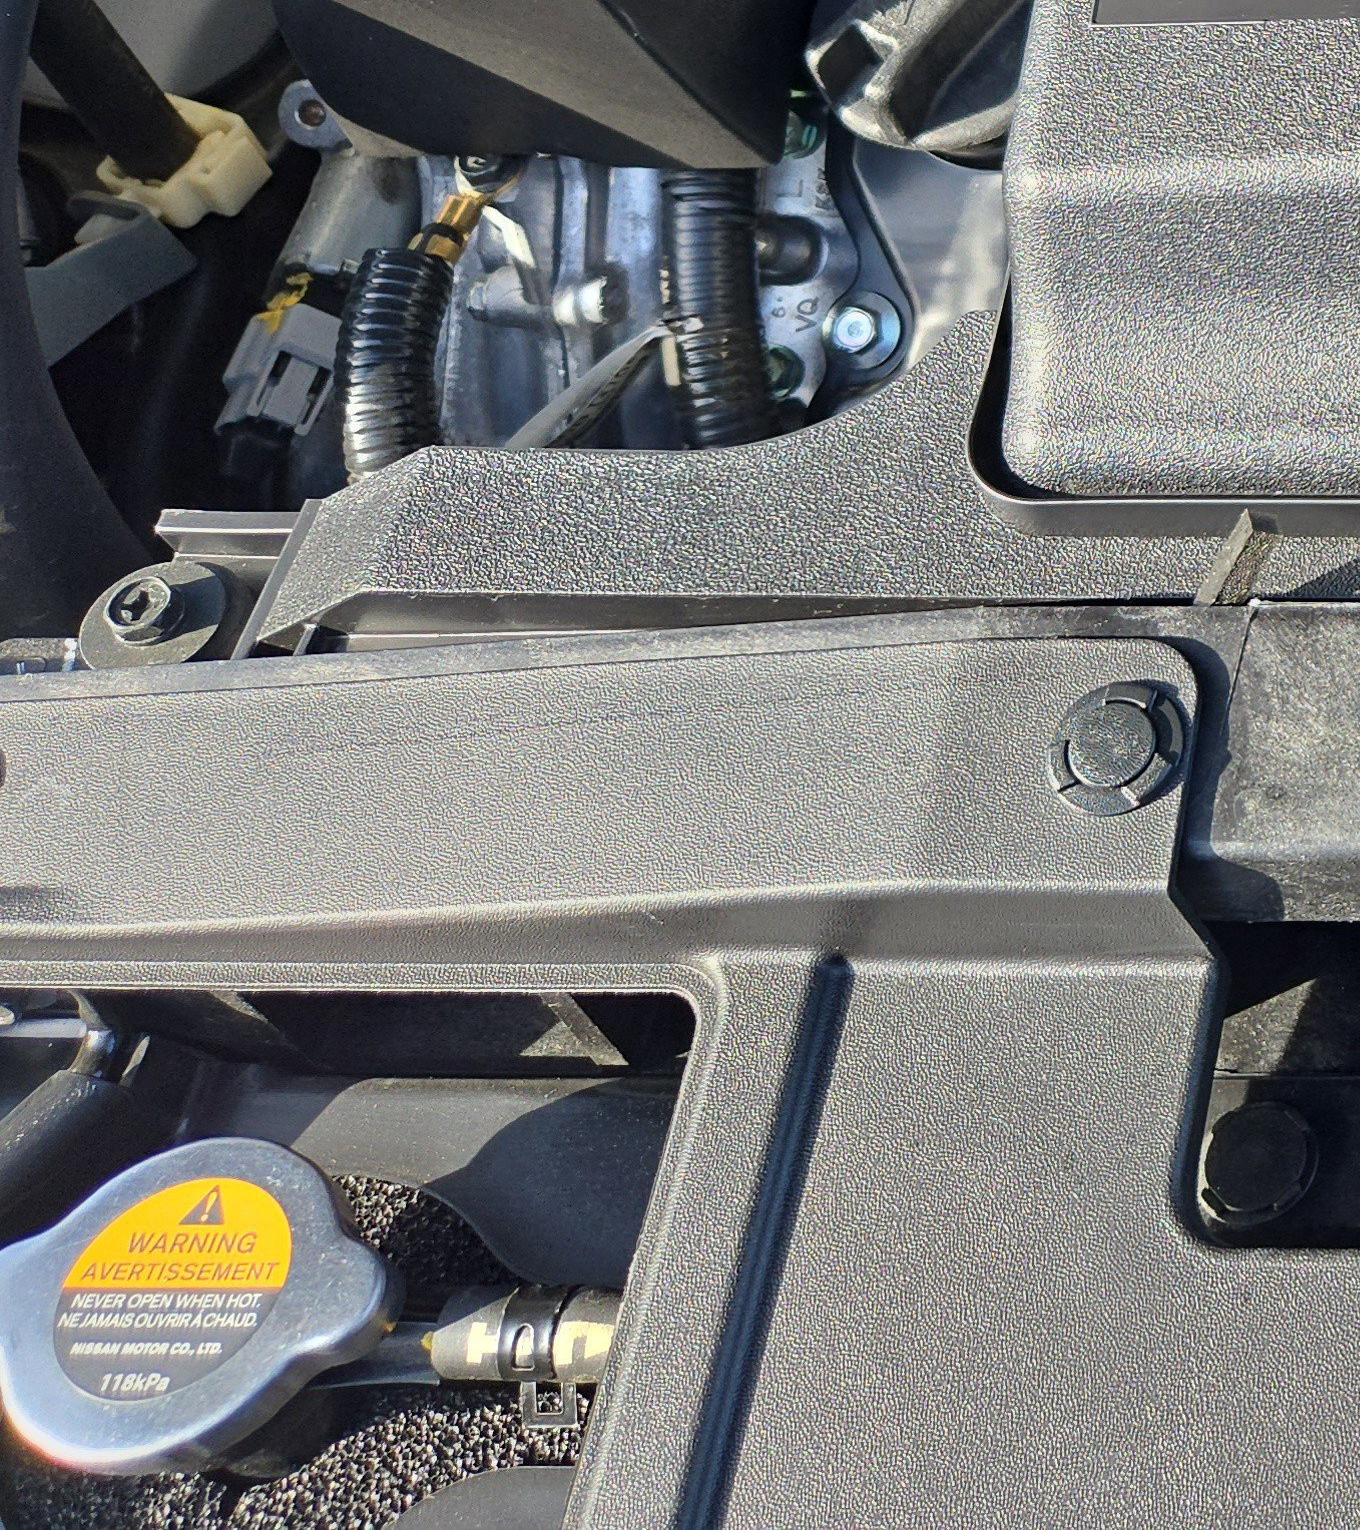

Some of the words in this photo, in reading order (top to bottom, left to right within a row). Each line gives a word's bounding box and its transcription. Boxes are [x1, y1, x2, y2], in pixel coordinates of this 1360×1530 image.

[128, 1231, 258, 1254] WARNING
[80, 1261, 280, 1282] AVERTISSEMENT
[70, 1293, 126, 1309] NEVER
[127, 1293, 174, 1309] OPEN
[175, 1293, 226, 1309] WHEN
[57, 1312, 83, 1329] NE
[79, 1313, 136, 1329] JAMAIS
[134, 1313, 193, 1328] OUVRIR
[202, 1312, 258, 1328] CHAUD.
[69, 1342, 121, 1356] NISSAN
[121, 1342, 170, 1356] MOTOR
